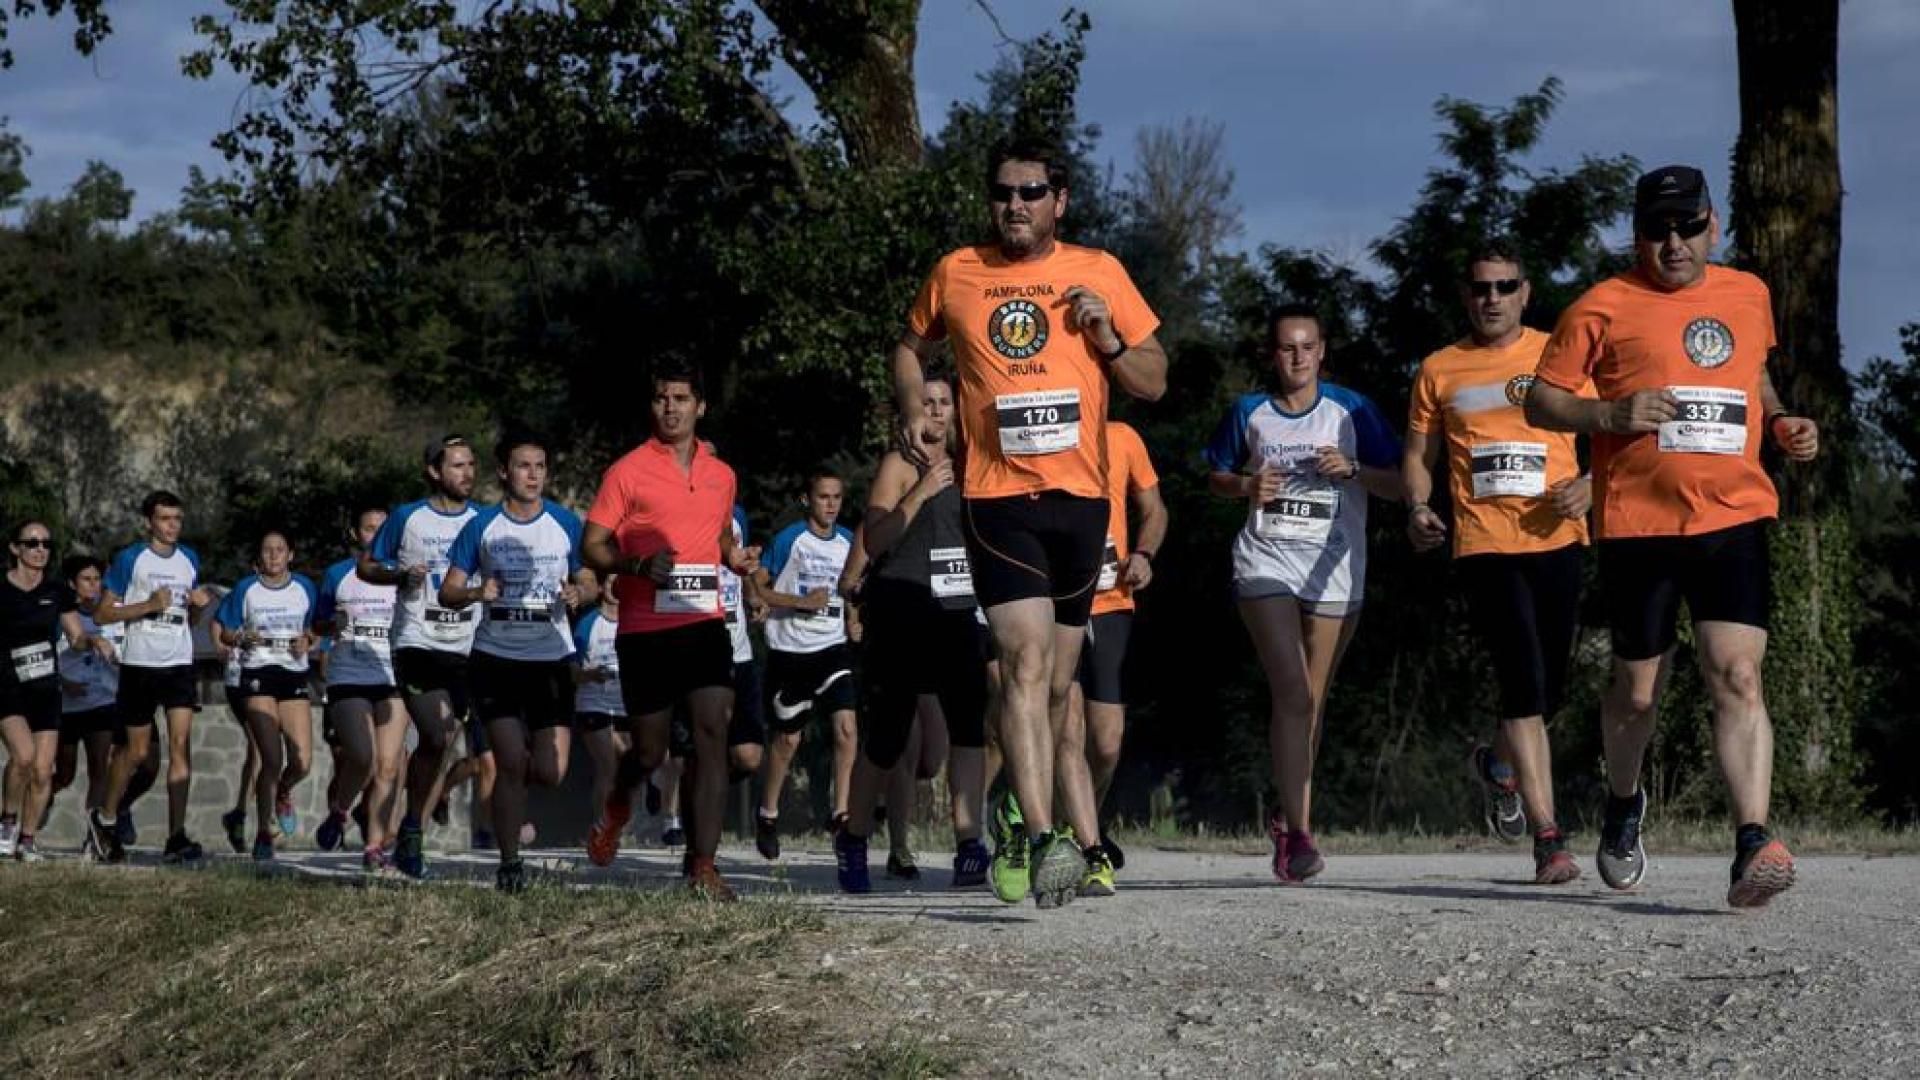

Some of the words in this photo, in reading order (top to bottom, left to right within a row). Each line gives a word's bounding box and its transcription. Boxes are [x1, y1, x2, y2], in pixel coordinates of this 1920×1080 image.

[984, 285, 1055, 298] PAMPLONA
[1008, 362, 1047, 376] IRUÑA
[1023, 406, 1058, 425] 170
[1685, 404, 1725, 419] 337
[1493, 456, 1523, 470] 115
[1282, 501, 1310, 516] 118
[676, 577, 701, 589] 174
